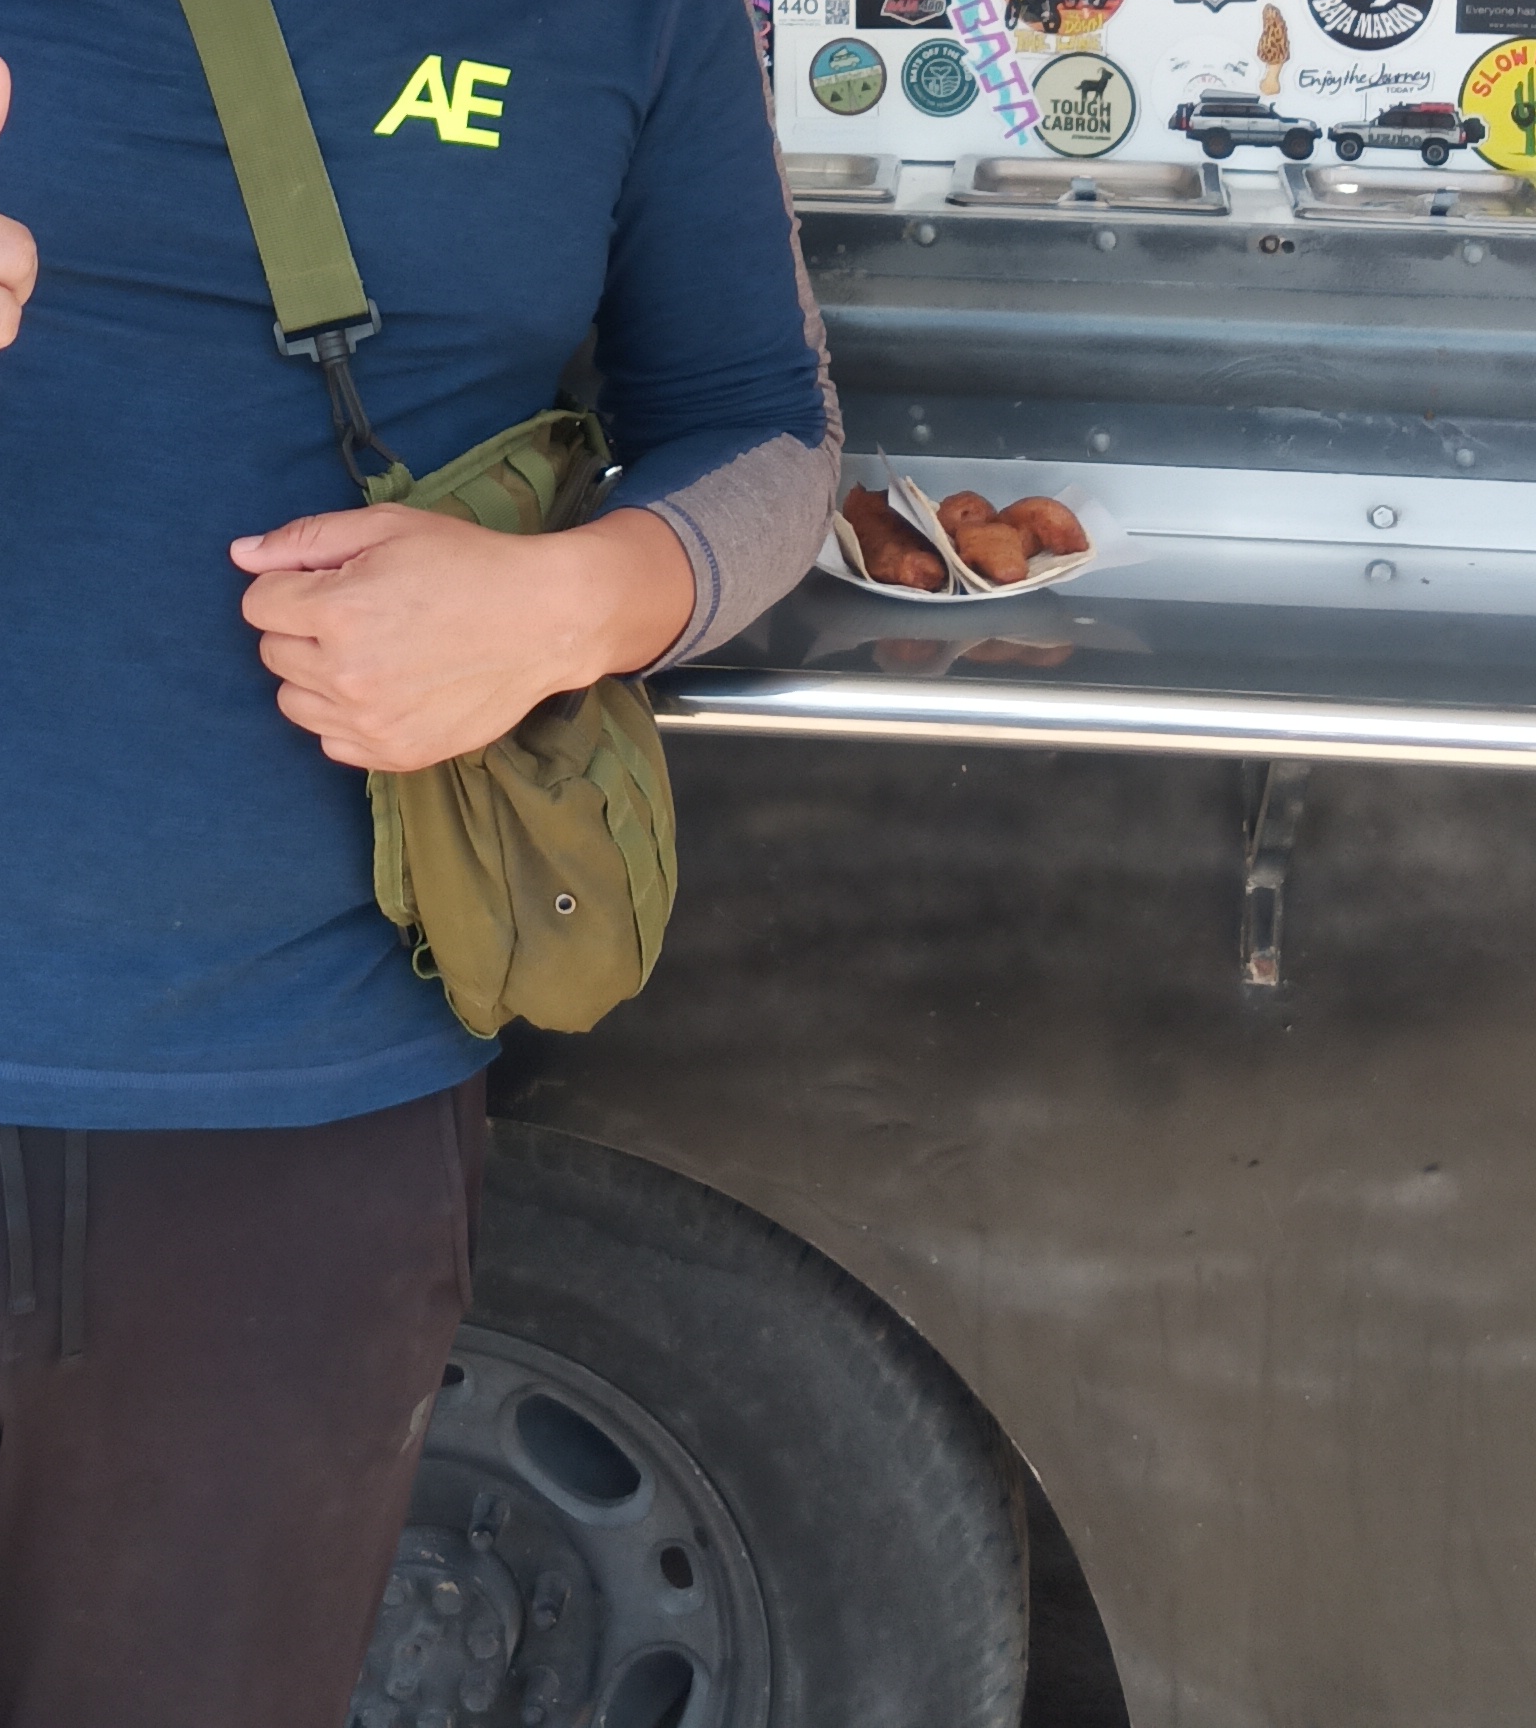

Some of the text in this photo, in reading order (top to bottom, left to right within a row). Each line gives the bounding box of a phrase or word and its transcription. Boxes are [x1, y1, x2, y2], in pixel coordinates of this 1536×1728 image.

[1465, 5, 1516, 19] Everyone
[1516, 5, 1536, 17] has
[1298, 65, 1431, 97] Enjoy Journey
[1471, 45, 1529, 99] SLOW
[373, 54, 512, 149] AE
[1385, 85, 1415, 94] TODAY
[1050, 98, 1112, 119] TOUGH
